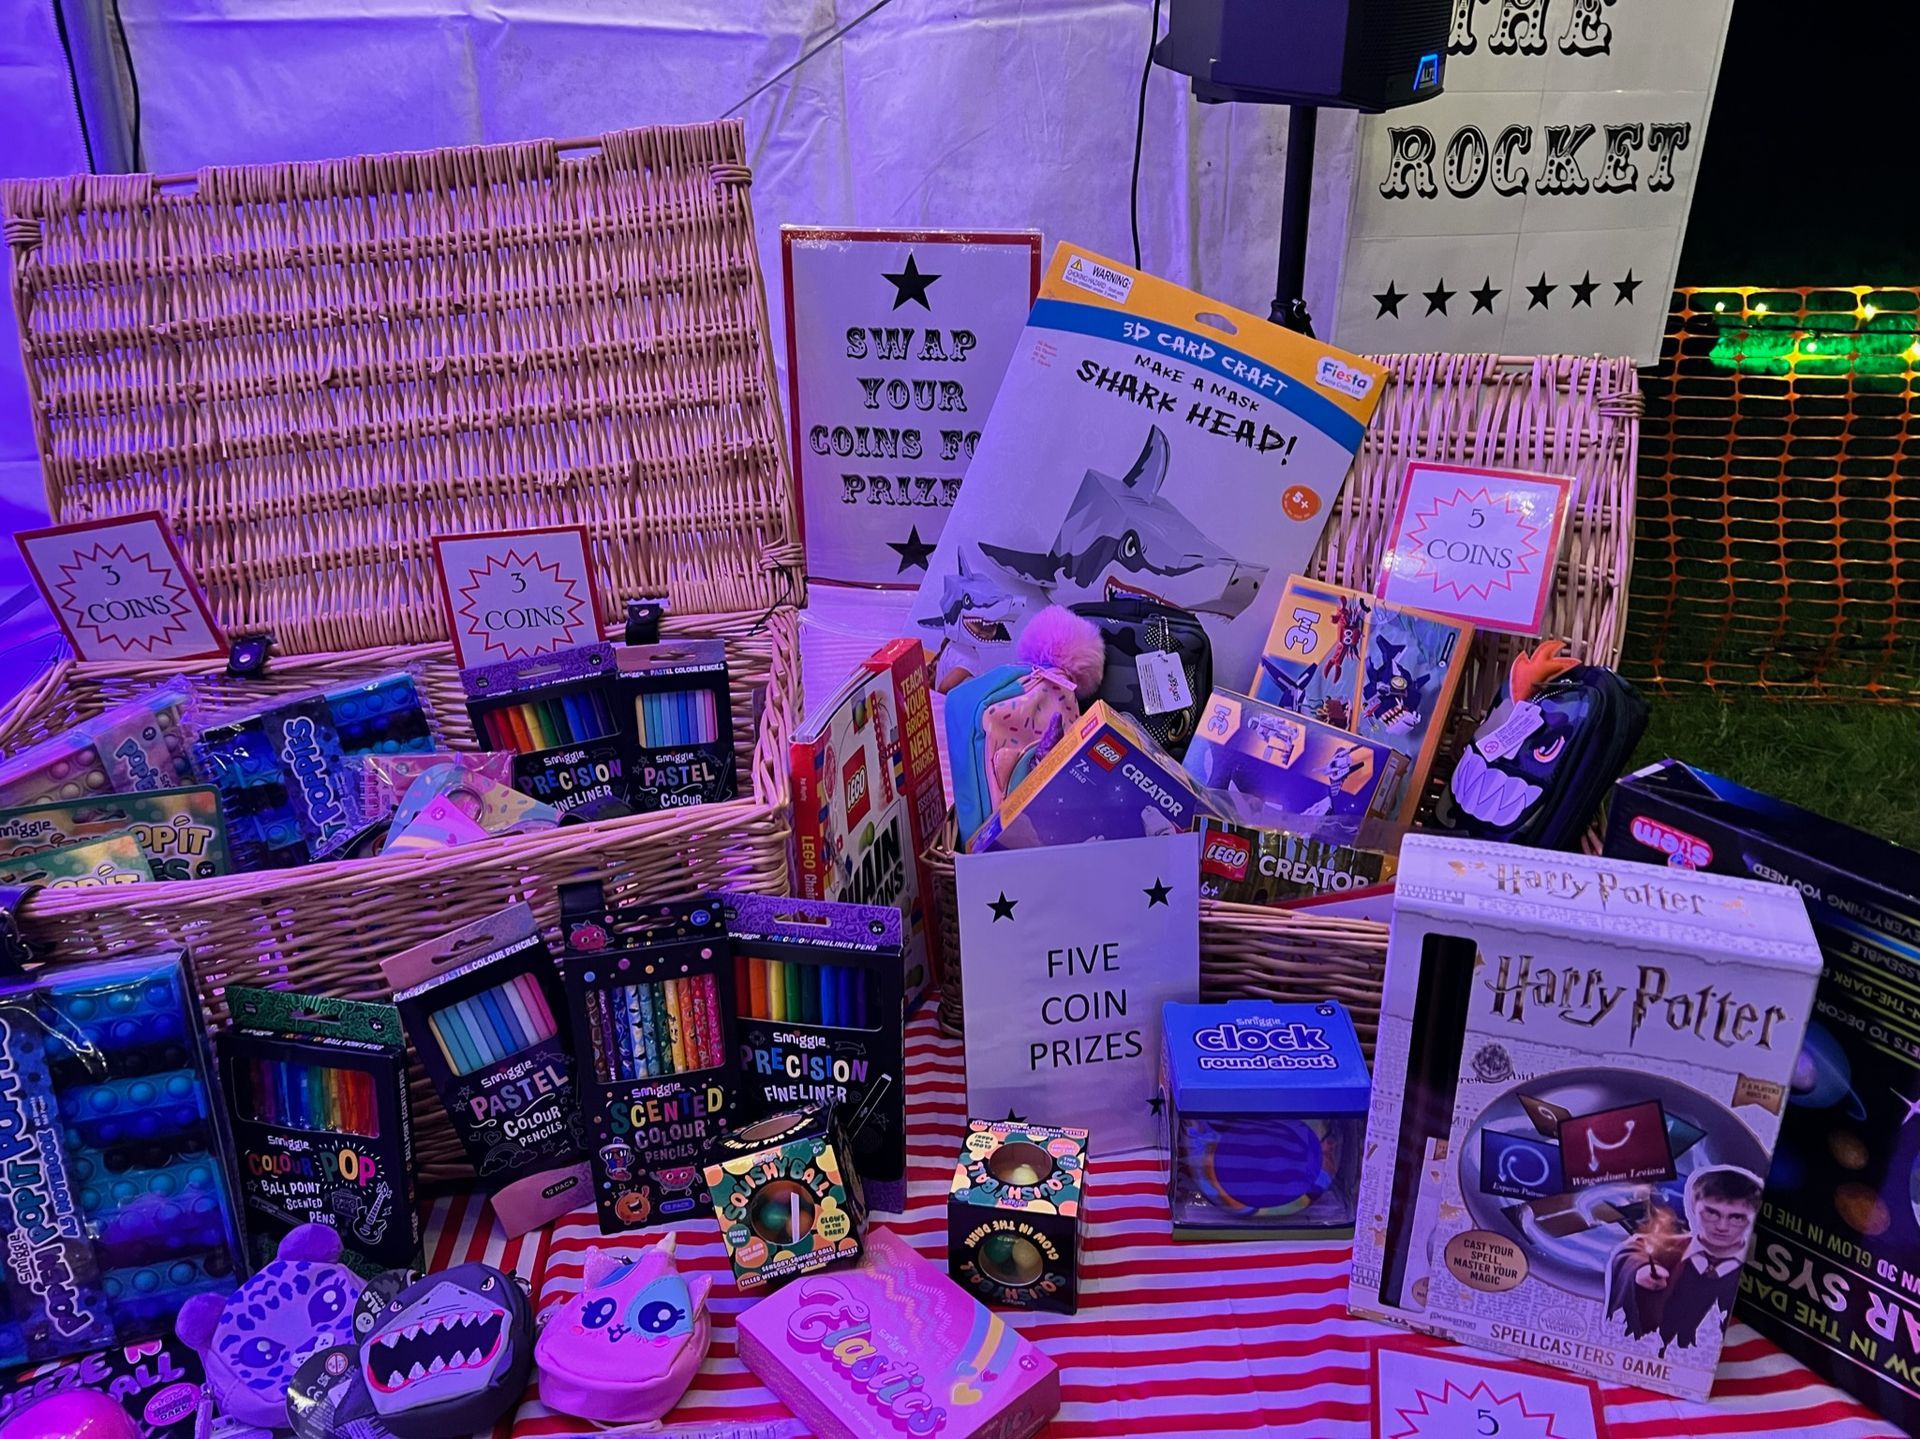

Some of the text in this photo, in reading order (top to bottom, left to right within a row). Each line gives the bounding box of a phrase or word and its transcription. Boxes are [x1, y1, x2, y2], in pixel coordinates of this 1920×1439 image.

[1379, 122, 1690, 200] ROCKET
[846, 327, 977, 361] SWAP
[1123, 321, 1289, 396] 3D CARD CRAFT
[1135, 353, 1260, 412] MAKE A MASK
[1322, 362, 1368, 389] Fiesta
[857, 377, 968, 412] YOUR
[1076, 360, 1298, 466] SHARK HEAD!
[809, 425, 982, 460] COINS FO
[841, 474, 964, 507] PRIZE
[1291, 491, 1310, 510] 5+
[1468, 508, 1485, 528] 5
[1427, 538, 1513, 569] COINS
[100, 565, 121, 587] 3
[511, 572, 528, 594] 3
[87, 595, 171, 623] COINS
[484, 605, 567, 632] COINS
[650, 663, 725, 676] PASTEL COLOUR PENCILS
[901, 665, 924, 697] TEACH
[904, 687, 926, 717] YOUR
[906, 706, 930, 734] BRICKS
[909, 724, 932, 761] NEW
[1095, 742, 1120, 763] LEGO
[543, 750, 588, 766] smiggle
[656, 753, 695, 766] smiggle
[911, 748, 935, 778] TRICKS
[1073, 758, 1090, 774] 7+
[518, 759, 622, 796] PRECISION
[644, 762, 715, 787] PASTEL
[847, 764, 867, 813] LEGO
[550, 784, 613, 812] INELINER
[660, 793, 702, 809] COLOUR
[1122, 763, 1184, 818] CREATOR
[0, 820, 51, 838] miggle
[801, 835, 816, 869] LEGO
[1205, 843, 1247, 867] LEGO
[1258, 855, 1374, 892] CREATOR
[1753, 862, 1790, 887] NEED
[1200, 881, 1219, 897] 6+
[1488, 862, 1592, 899] Harry
[1598, 871, 1706, 914] Potter
[1791, 878, 1821, 901] YOU
[767, 935, 810, 944] PRECISION
[811, 939, 854, 949] FINELINER
[854, 943, 878, 951] PENS
[439, 965, 471, 984] PASTEL
[472, 950, 505, 970] COLOUR
[505, 935, 539, 957] PENCILS
[1047, 942, 1121, 978] FIVE
[1041, 989, 1127, 1025] COIN
[1484, 954, 1787, 1050] Harry Potter
[1236, 1016, 1282, 1028] smiggle
[1814, 998, 1889, 1043] TO DECOR
[773, 1031, 827, 1049] smiggle
[1030, 1030, 1143, 1071] PRIZES
[1196, 1024, 1330, 1052] clock
[481, 1059, 534, 1088] smiggle
[741, 1047, 869, 1083] PRECISION
[1201, 1055, 1337, 1070] round about
[469, 1062, 569, 1121] PASTEL
[631, 1082, 682, 1098] smiggle
[764, 1084, 847, 1103] FINELINER
[503, 1106, 562, 1138] COLOUR
[610, 1087, 723, 1135] SCENTED
[267, 1134, 311, 1151] smiggle
[519, 1122, 563, 1148] PENCILS
[635, 1121, 706, 1149] COLOUR
[38, 1128, 74, 1214] NOTEBOOK
[249, 1149, 376, 1186] COLOUR POP
[261, 1180, 321, 1196] BALL POINT
[553, 1178, 575, 1194] PACK
[725, 1156, 790, 1220] SQUISHY
[994, 1171, 1074, 1201] SQUISHY
[285, 1198, 323, 1210] SCENTED
[309, 1211, 335, 1225] PENS
[820, 1214, 845, 1224] GLOWS
[1776, 1213, 1803, 1236] THE
[964, 1220, 1060, 1260] GLOW IN THE DARK
[1464, 1239, 1514, 1258] CAST YOUR
[1808, 1227, 1824, 1245] IN
[9, 1232, 33, 1284] smiggle
[1827, 1235, 1873, 1268] GLOW
[1453, 1257, 1518, 1279] MASTER YOUR
[1470, 1271, 1501, 1285] MAGIC
[1744, 1233, 1850, 1312] SYST
[1876, 1259, 1896, 1282] 3D
[1739, 1275, 1788, 1310] DAR
[1796, 1308, 1841, 1343] THE
[1490, 1323, 1615, 1367] SPELLCASTERS
[1621, 1356, 1673, 1381] GAME
[1850, 1330, 1877, 1361] IN
[1477, 1409, 1499, 1436] 5
